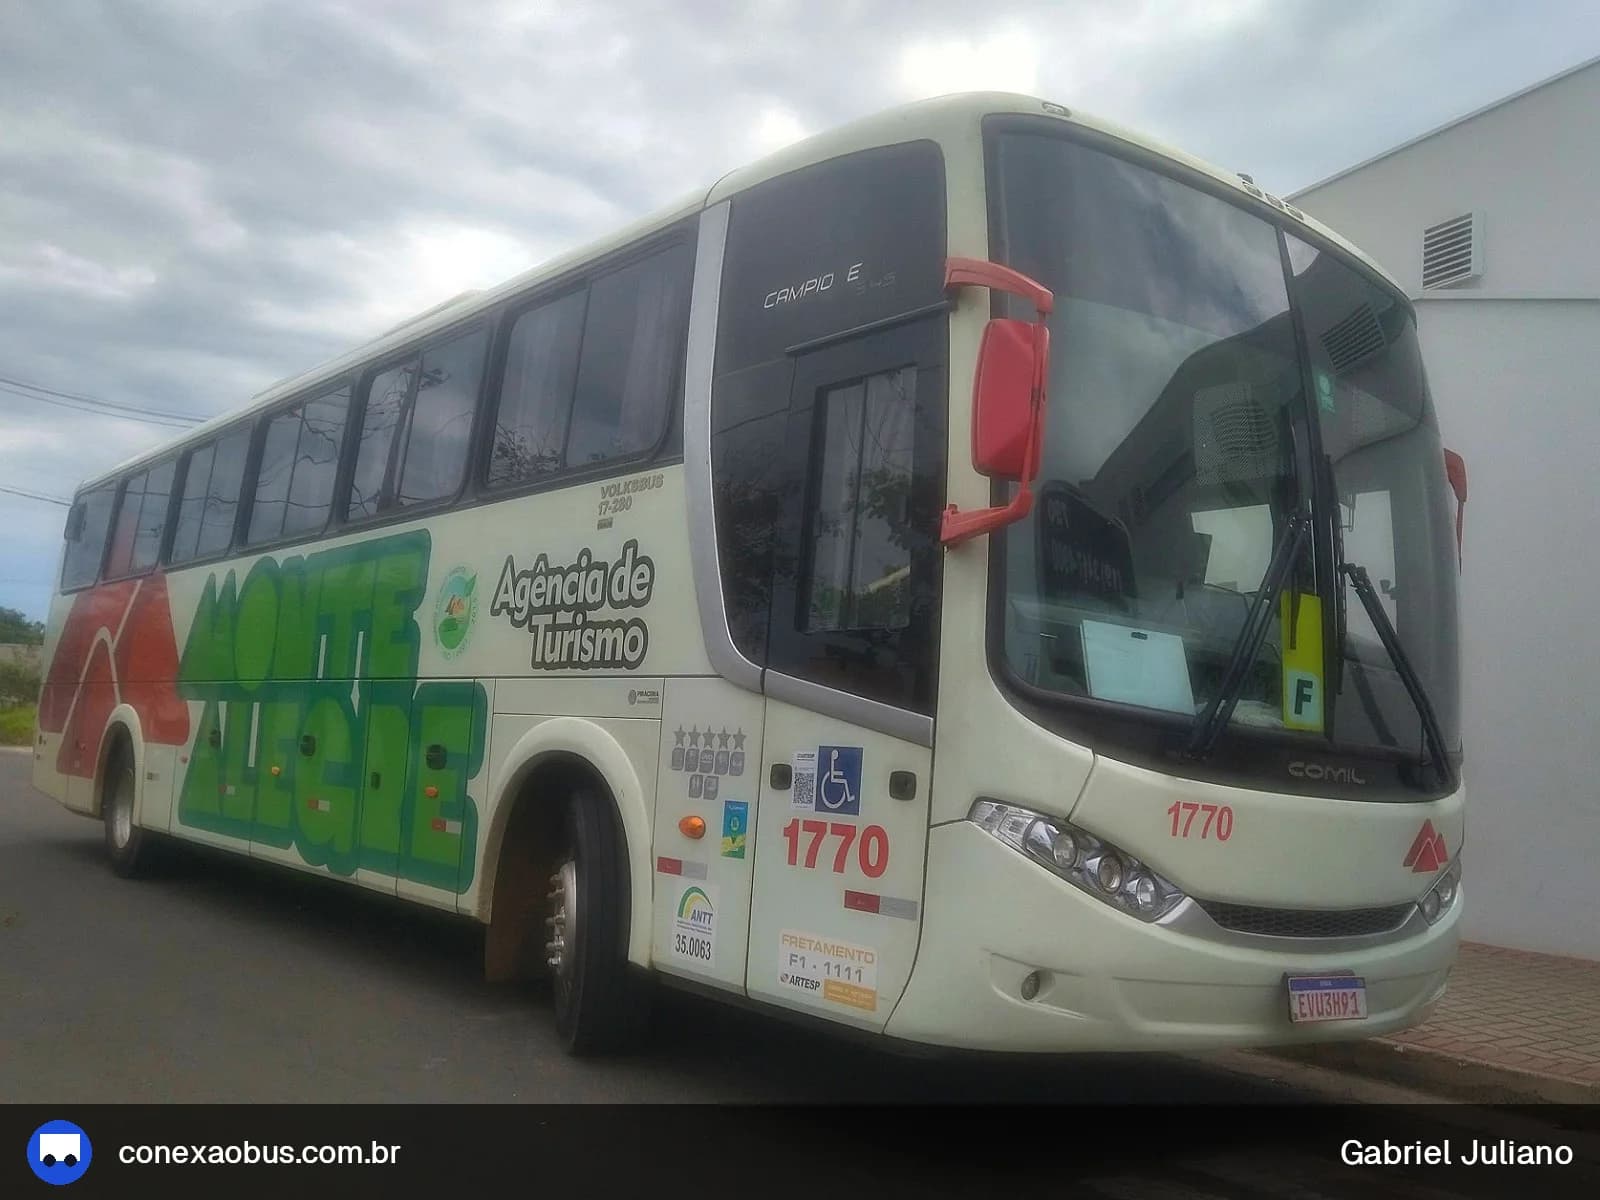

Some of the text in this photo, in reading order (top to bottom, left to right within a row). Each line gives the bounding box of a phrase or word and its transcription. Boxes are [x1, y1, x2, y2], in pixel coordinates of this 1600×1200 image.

[600, 473, 665, 499] VOLKSBUS
[598, 495, 634, 516] 17-280
[490, 547, 608, 628] Agência
[607, 538, 655, 609] de
[178, 527, 432, 702] MONTE
[529, 610, 648, 671] Turismo
[1294, 678, 1314, 715] F
[1287, 760, 1366, 785] COMIL
[178, 681, 488, 896] ALEGRE
[1167, 800, 1234, 842] 1770
[783, 817, 890, 879] 1770
[690, 908, 714, 925] ANTT
[675, 933, 711, 961] 35.0063
[781, 934, 875, 964] FRETAMENTO
[788, 975, 821, 991] ARTESP
[789, 953, 807, 969] F1
[823, 961, 862, 983] 1111
